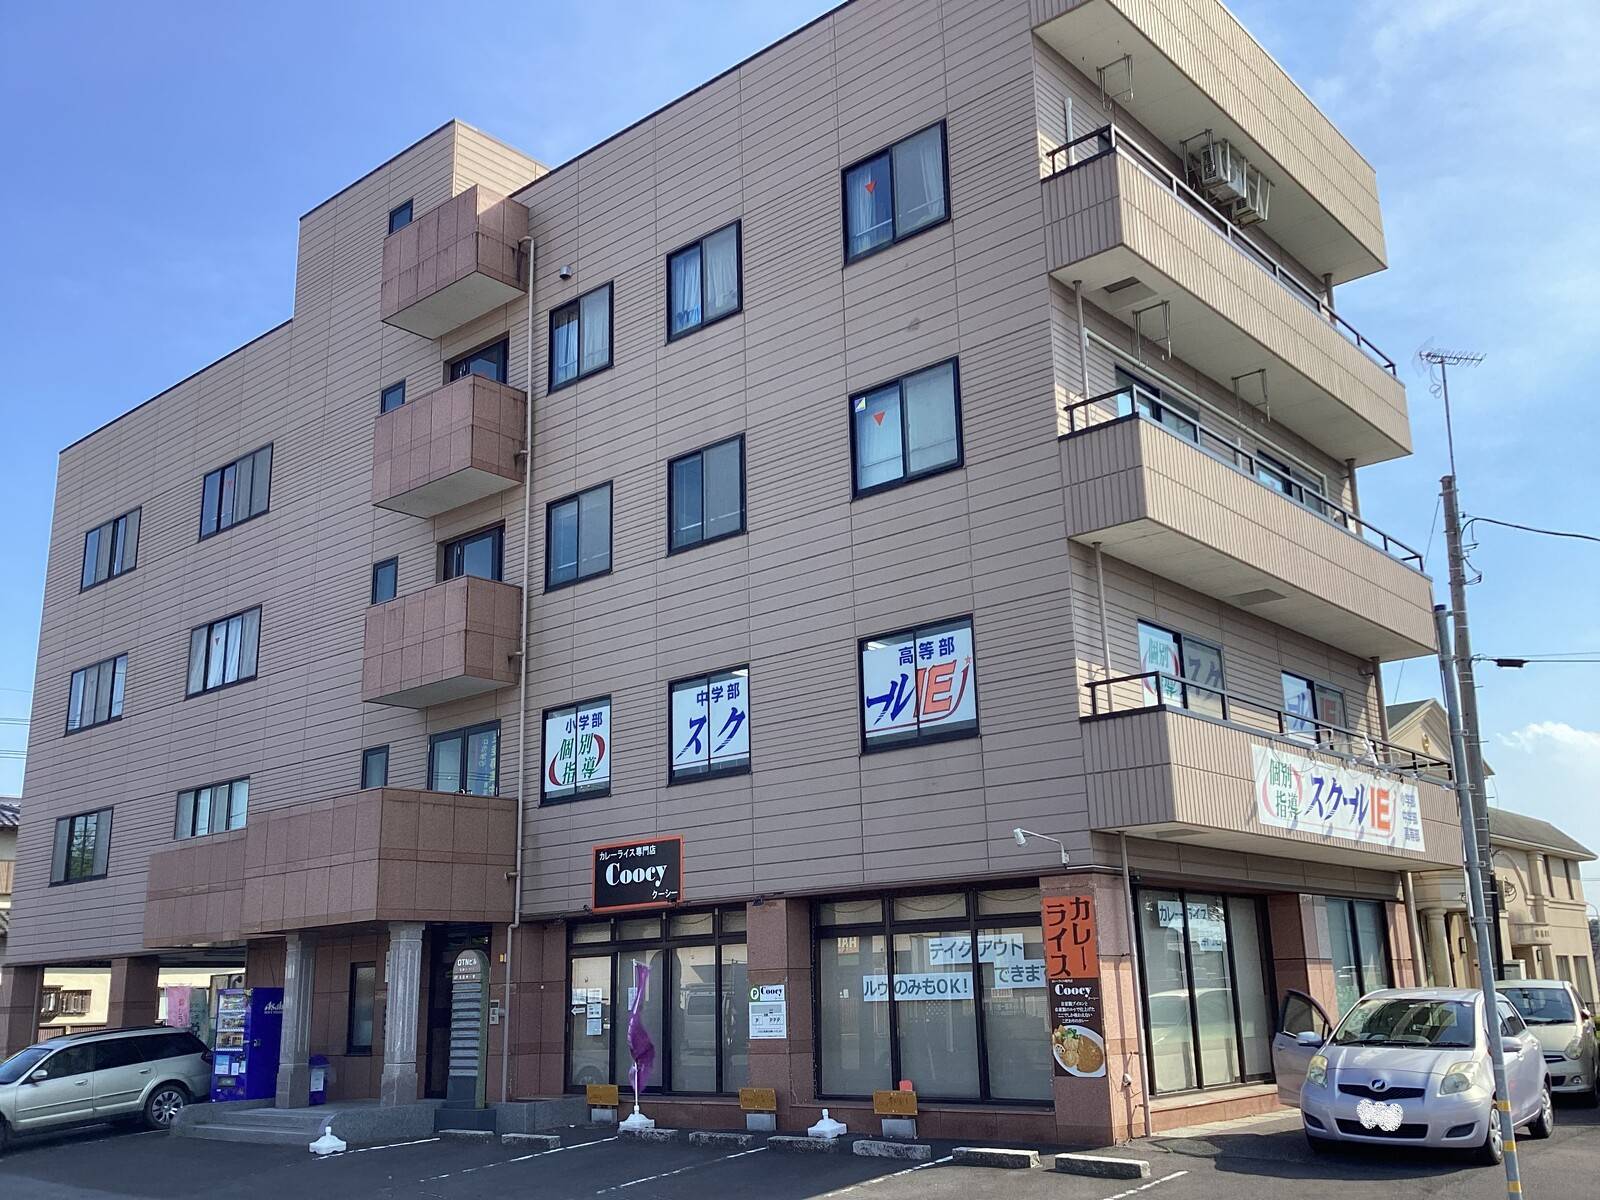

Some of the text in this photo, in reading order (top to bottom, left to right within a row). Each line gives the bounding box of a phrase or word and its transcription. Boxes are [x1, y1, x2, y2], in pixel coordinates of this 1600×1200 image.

[897, 635, 956, 666] 高等部
[1148, 638, 1170, 669] 個別
[695, 681, 741, 706] 中学部
[565, 710, 603, 734] 小学部
[675, 705, 747, 761] スク
[558, 731, 593, 762] 個別
[560, 754, 597, 787] 指導
[1269, 759, 1293, 790] 個別
[1275, 790, 1304, 820] 指導
[599, 844, 657, 861] カレーライス専門店
[605, 862, 668, 888] Coocy
[651, 888, 679, 900] クーシー
[1045, 903, 1072, 978] ライス
[1070, 896, 1092, 971] カレー
[929, 937, 1024, 961] テイクアウト
[760, 986, 783, 997] Coocy
[1054, 983, 1092, 998] Coocy
